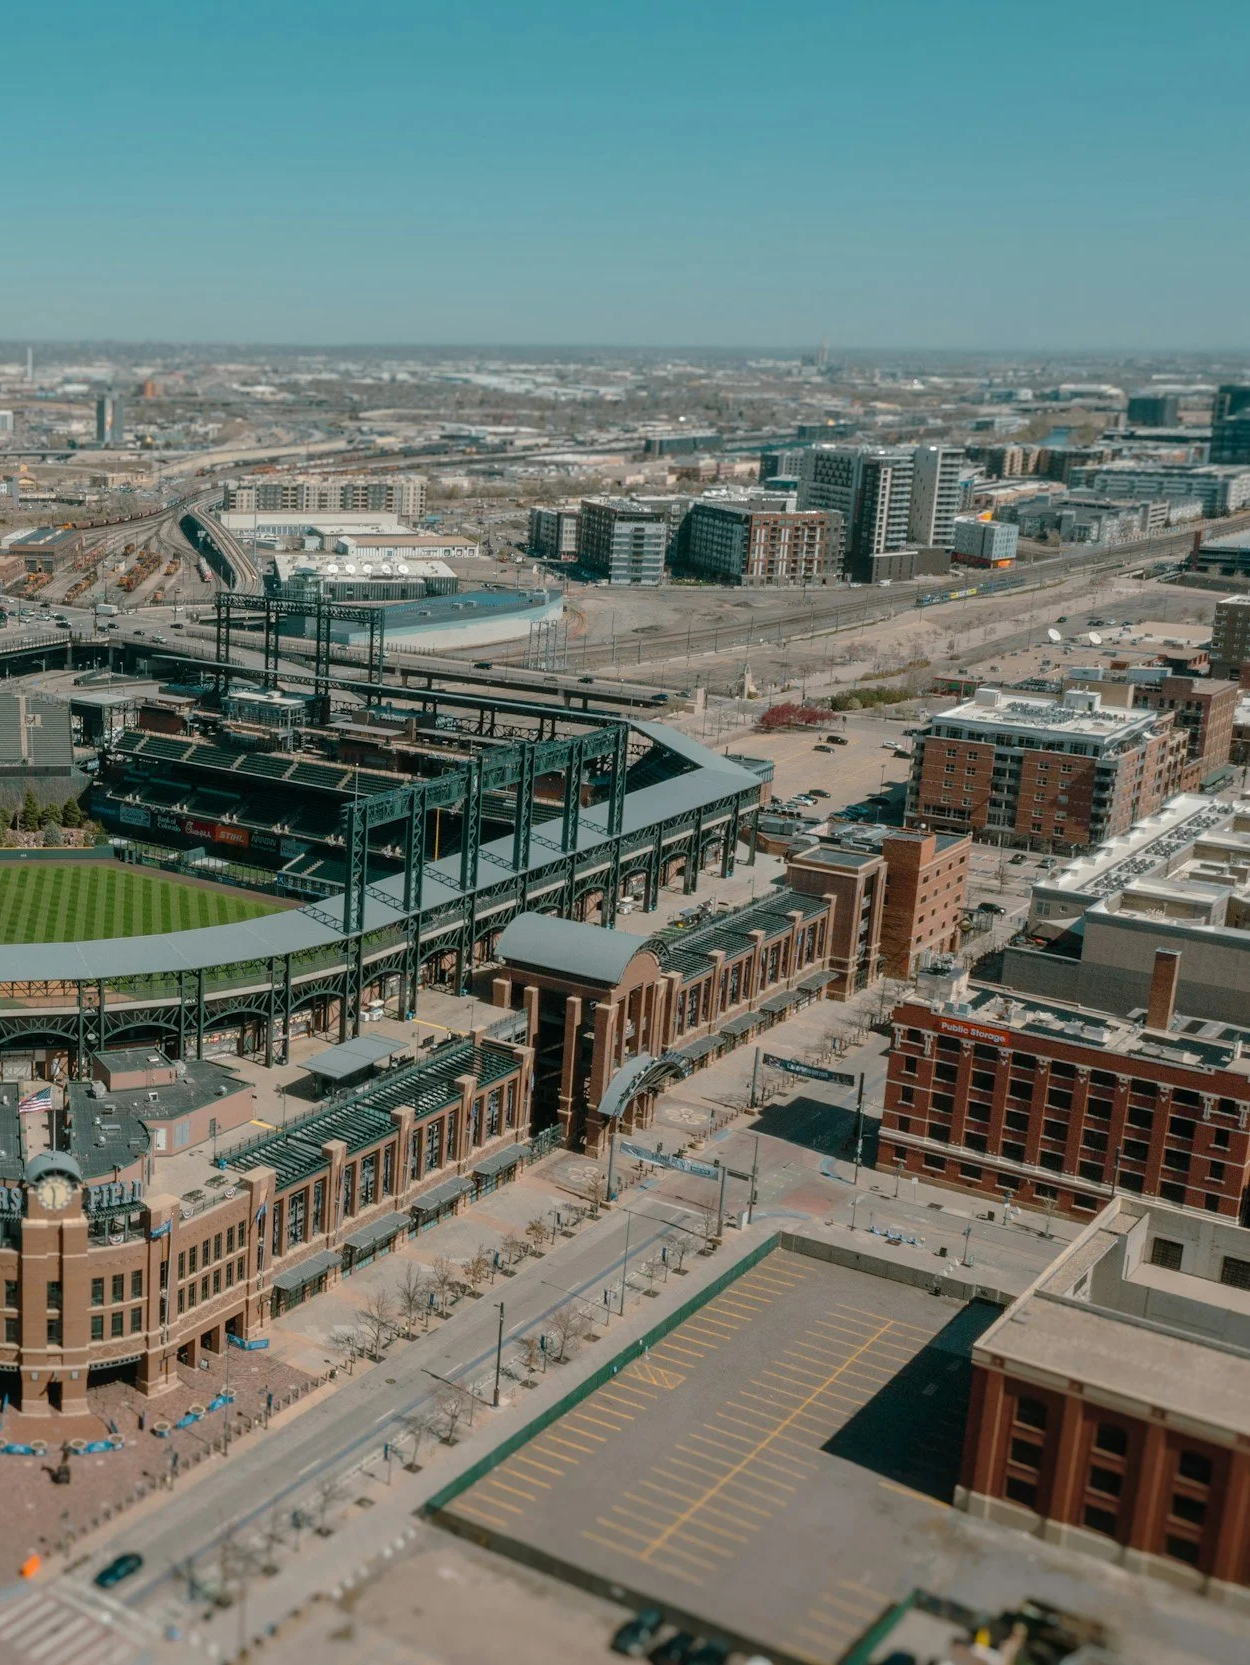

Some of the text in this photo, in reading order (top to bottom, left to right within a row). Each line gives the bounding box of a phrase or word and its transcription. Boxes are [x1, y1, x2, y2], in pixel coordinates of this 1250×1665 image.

[157, 815, 170, 823] Bank
[157, 822, 181, 832] Colorado
[219, 831, 244, 843] STIHL
[941, 1022, 1006, 1043] Public Storage
[89, 1181, 143, 1210] FIELD
